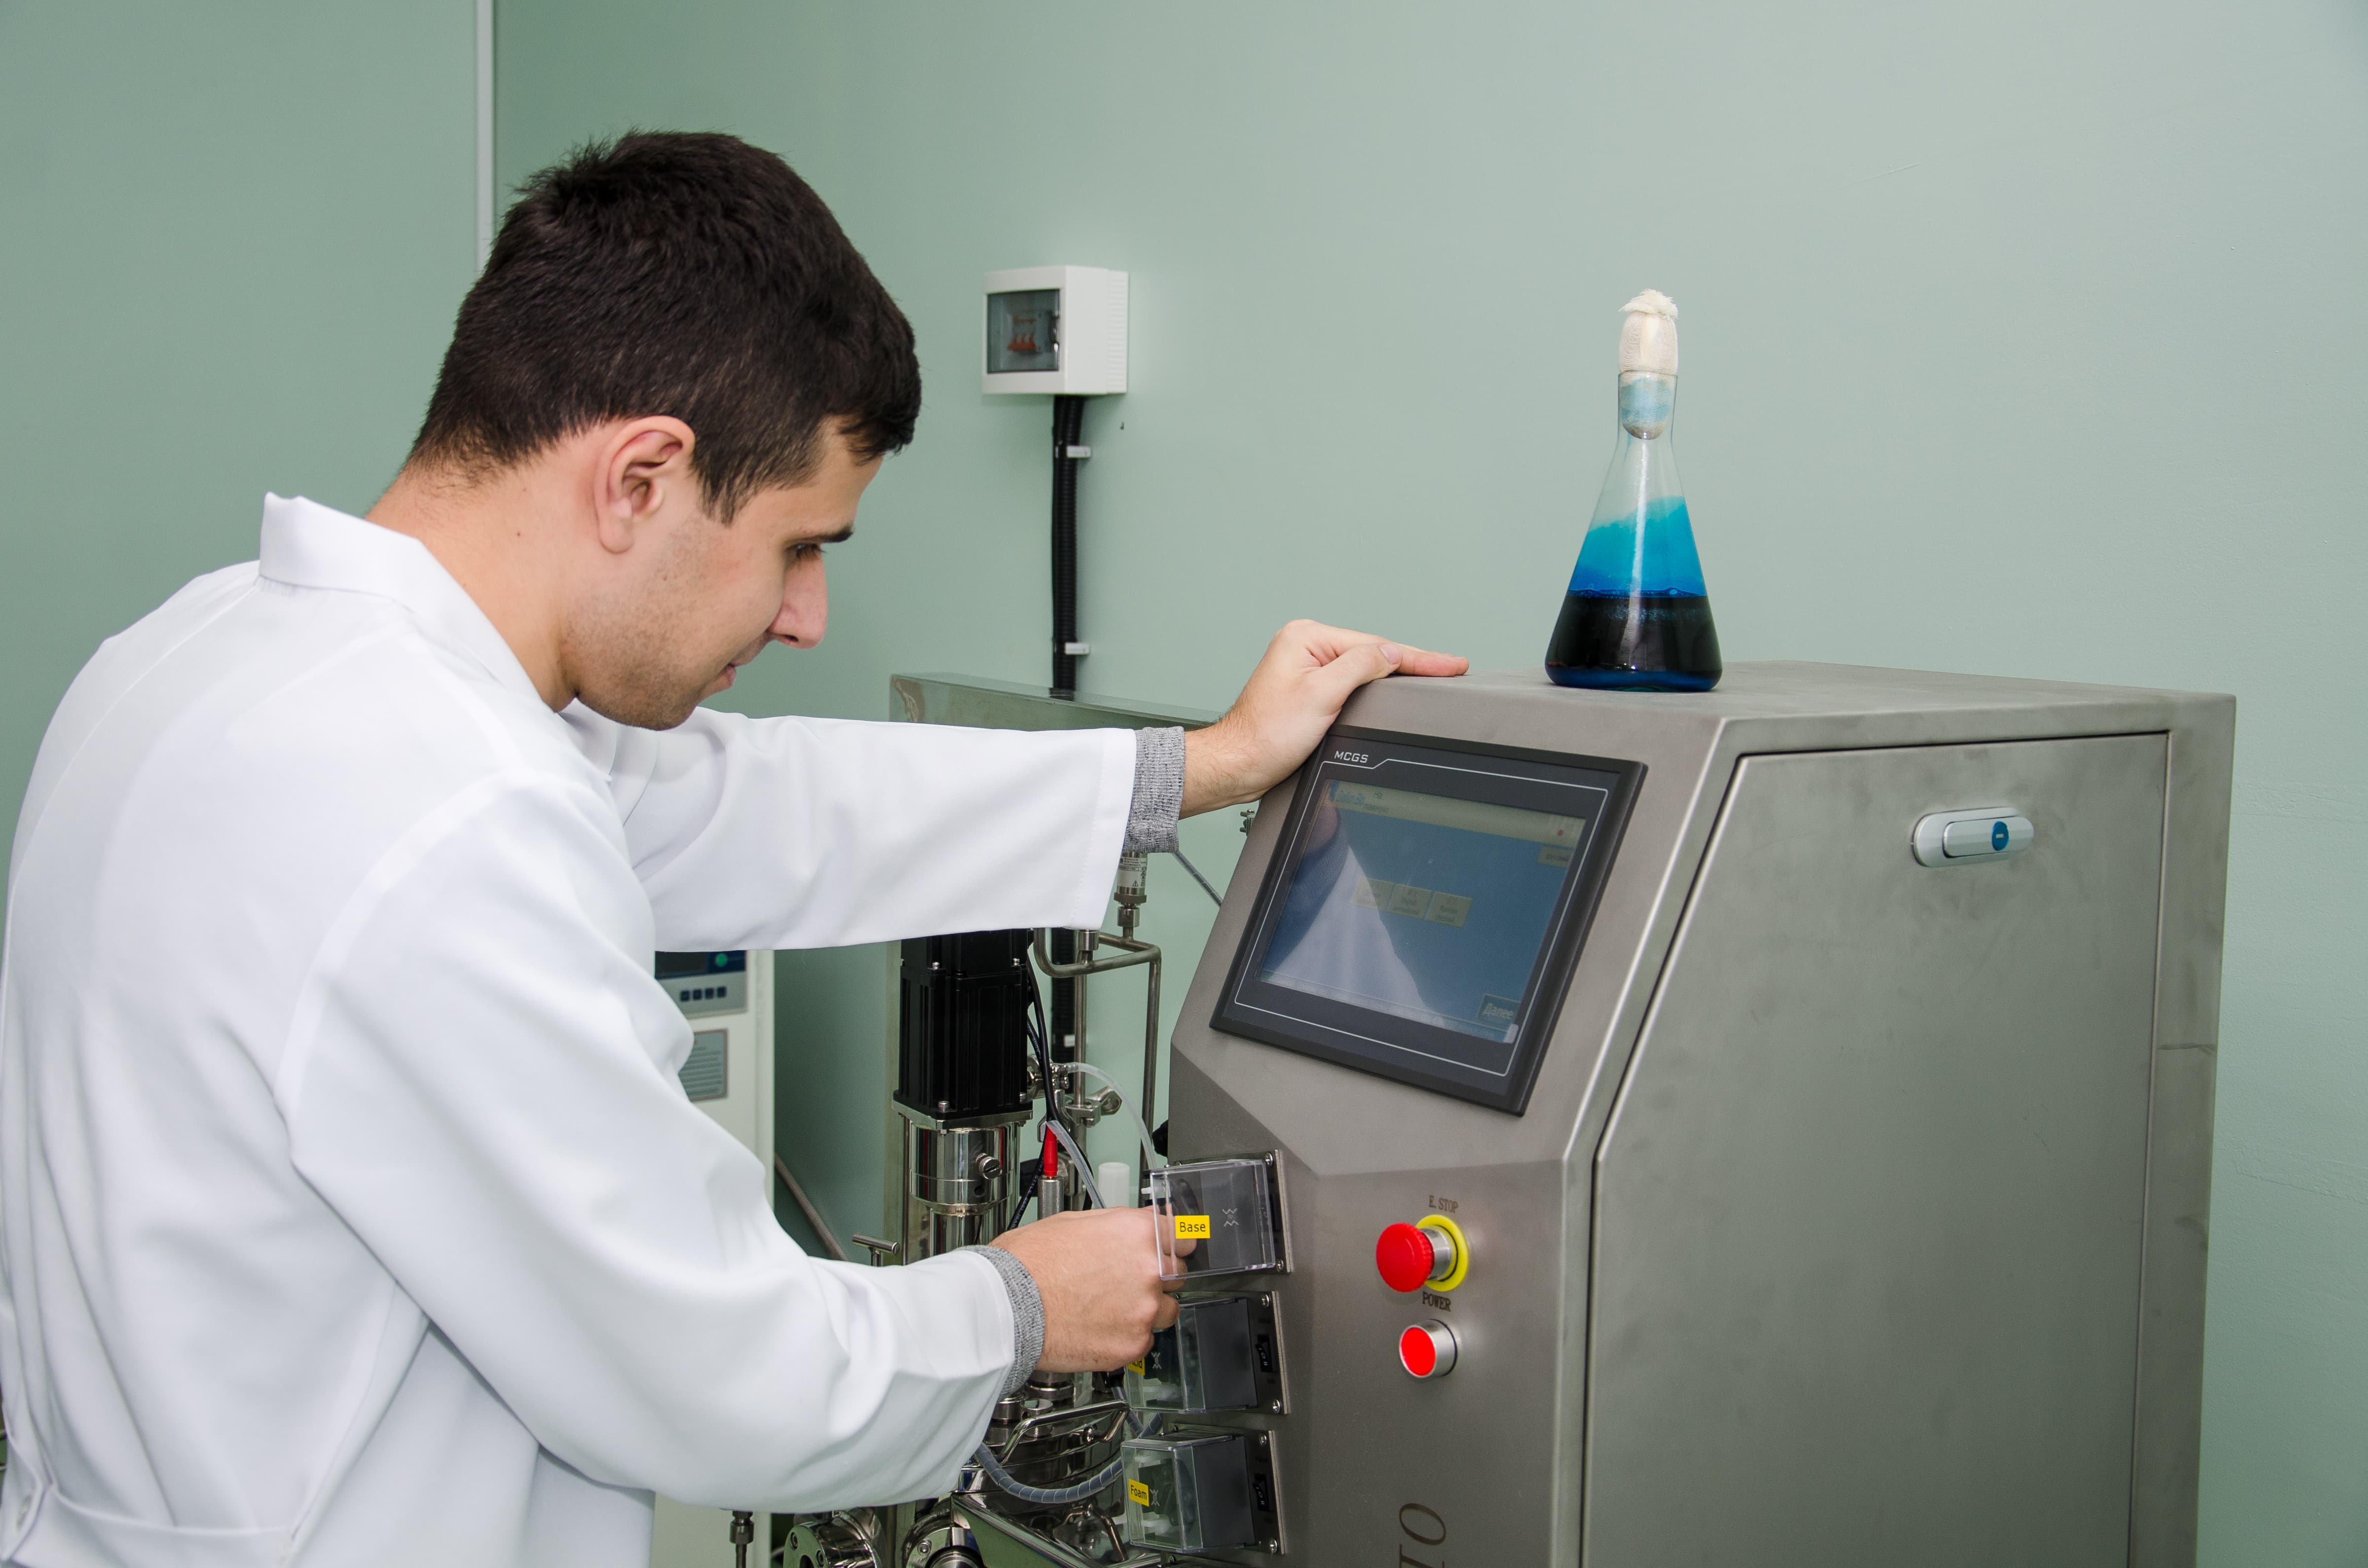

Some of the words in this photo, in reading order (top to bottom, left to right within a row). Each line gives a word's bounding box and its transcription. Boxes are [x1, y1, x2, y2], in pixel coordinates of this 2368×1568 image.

[1333, 750, 1369, 764] MCGS
[1438, 1198, 1459, 1214] STOP
[1179, 1222, 1207, 1233] Base
[1422, 1291, 1451, 1312] POWER
[1130, 1484, 1147, 1500] Foam
